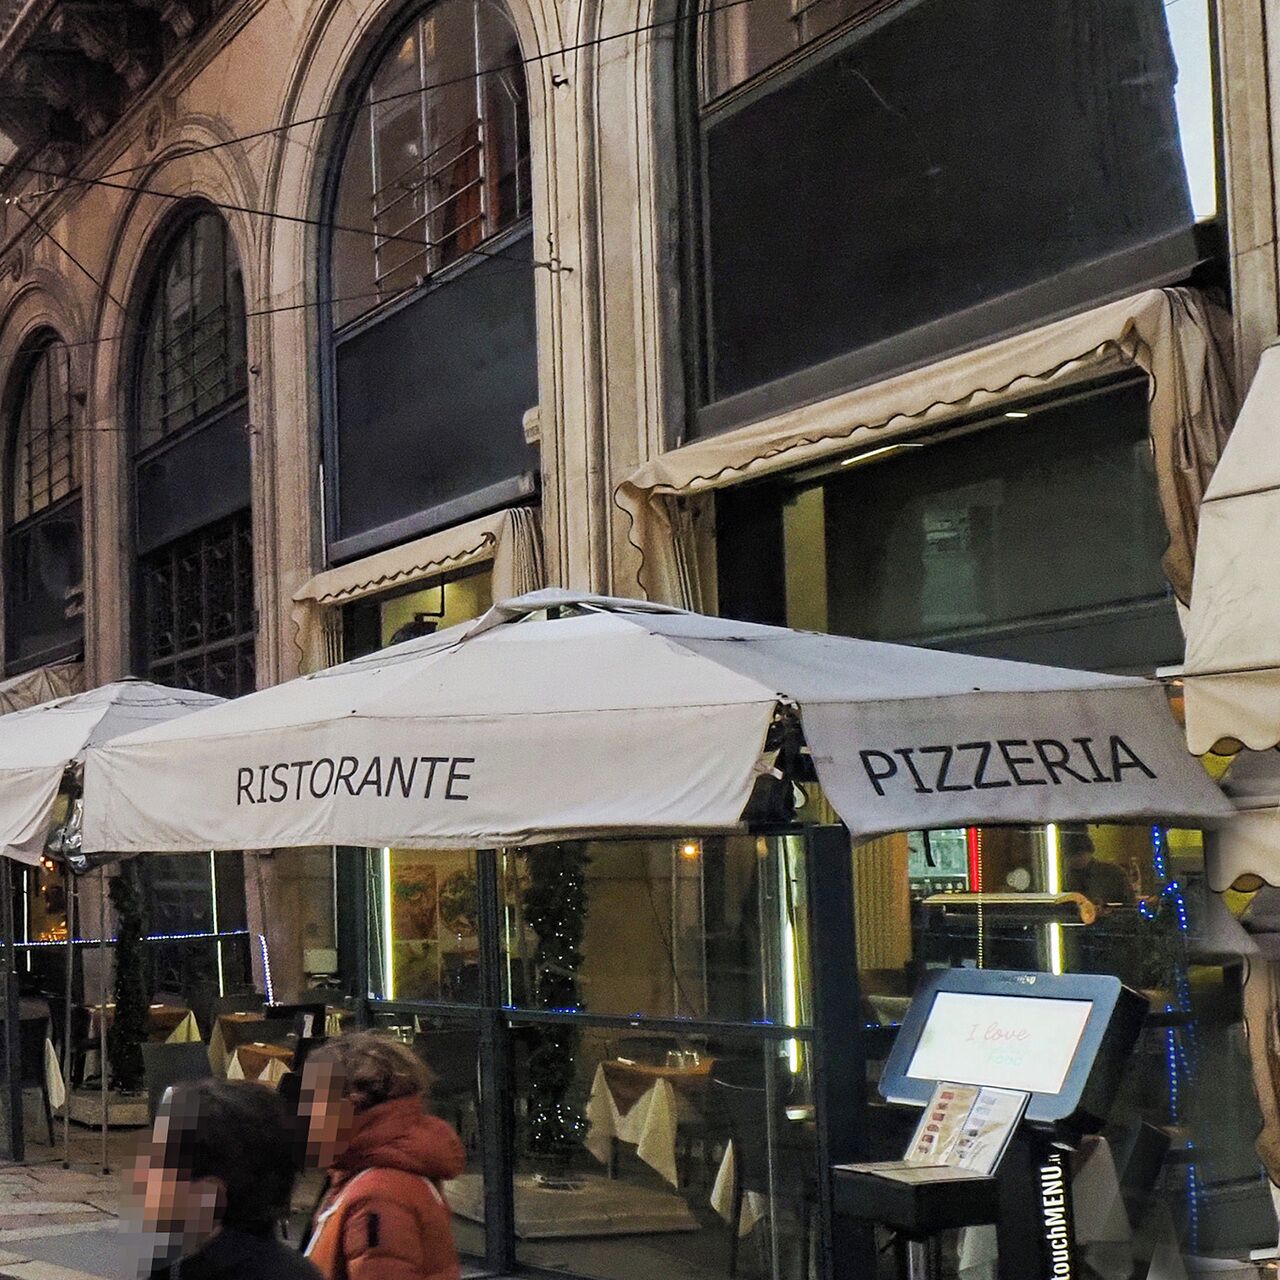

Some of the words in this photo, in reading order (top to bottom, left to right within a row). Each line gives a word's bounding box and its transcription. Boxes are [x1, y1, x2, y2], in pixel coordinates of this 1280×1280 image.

[236, 755, 476, 806] RISTORANTE
[858, 734, 1158, 797] PIZZERIA
[983, 1022, 1031, 1042] love
